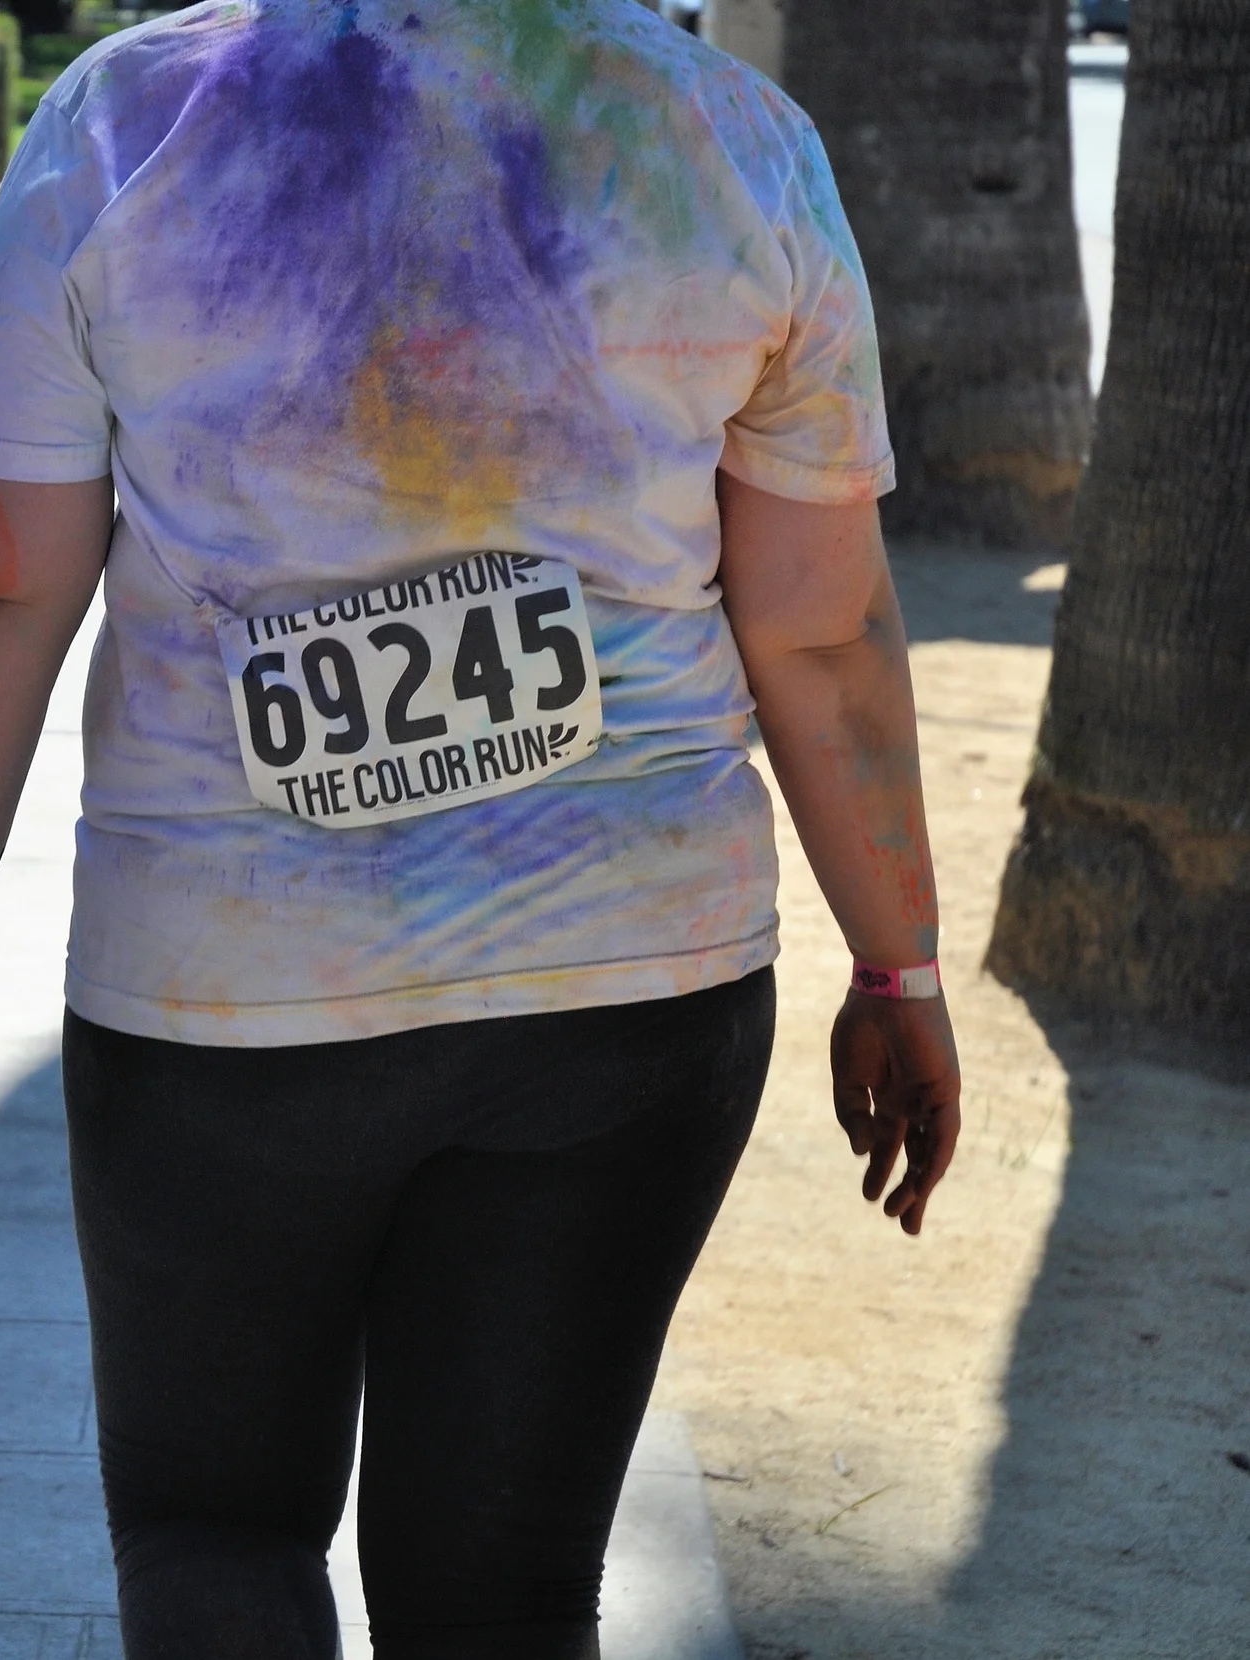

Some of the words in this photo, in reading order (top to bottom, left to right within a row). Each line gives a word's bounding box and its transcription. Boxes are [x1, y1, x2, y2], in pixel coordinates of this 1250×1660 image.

[438, 551, 513, 602] RUN
[242, 586, 587, 768] 69245
[277, 769, 350, 818] THE
[353, 744, 472, 810] COLOR
[473, 724, 550, 783] RUN
